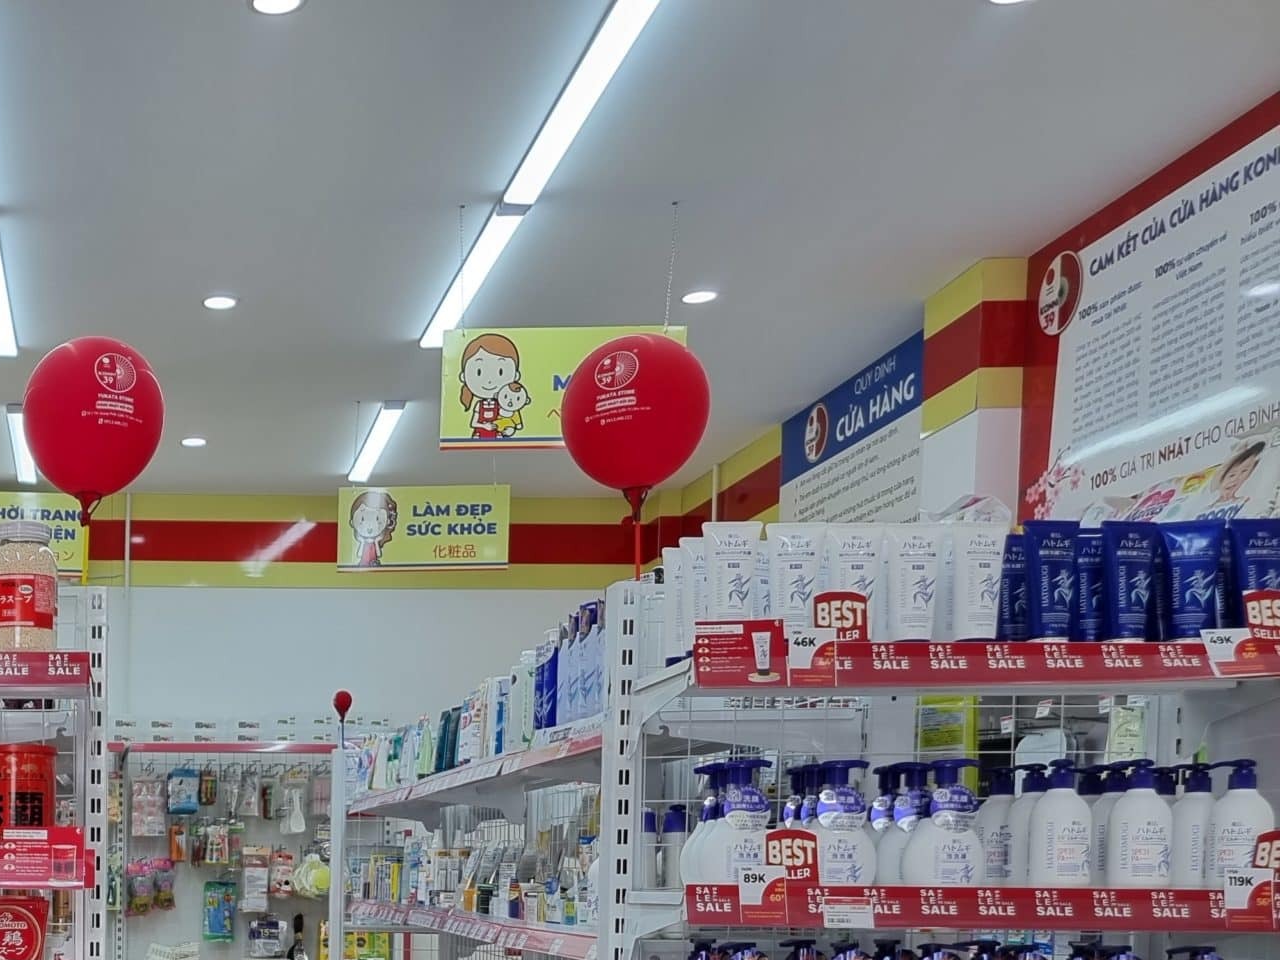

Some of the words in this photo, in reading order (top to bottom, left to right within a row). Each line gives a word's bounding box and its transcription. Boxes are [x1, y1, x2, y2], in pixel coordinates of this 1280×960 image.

[1089, 254, 1114, 277] CAM
[1117, 231, 1139, 262] KẾT
[1141, 217, 1166, 246] CỦA
[1170, 199, 1196, 228] CỬA
[1199, 178, 1239, 212] HÀNG
[854, 371, 873, 395] QUY
[835, 405, 864, 442] CỬA
[869, 372, 915, 424] HÀNG
[1090, 467, 1117, 490] 100%
[1120, 455, 1137, 479] GIÁ
[1158, 436, 1191, 465] NHẬT
[1194, 425, 1221, 450] CHO
[1224, 415, 1245, 438] GIA
[412, 501, 450, 517] LÀM
[456, 504, 492, 521] ĐẸP
[406, 517, 441, 537] SỨC
[447, 517, 497, 536] KHỎE
[433, 544, 476, 559] 化粧品
[817, 601, 864, 628] BEST
[793, 637, 816, 647] 46K
[1209, 635, 1233, 645] 49K
[47, 667, 80, 675] SALE
[873, 660, 910, 669] SALE
[1163, 657, 1201, 667] SALE
[769, 838, 815, 866] BEST
[743, 873, 765, 883] 89K
[1228, 876, 1253, 886] 119K
[696, 902, 732, 912] SALE
[1152, 908, 1190, 918] SALE
